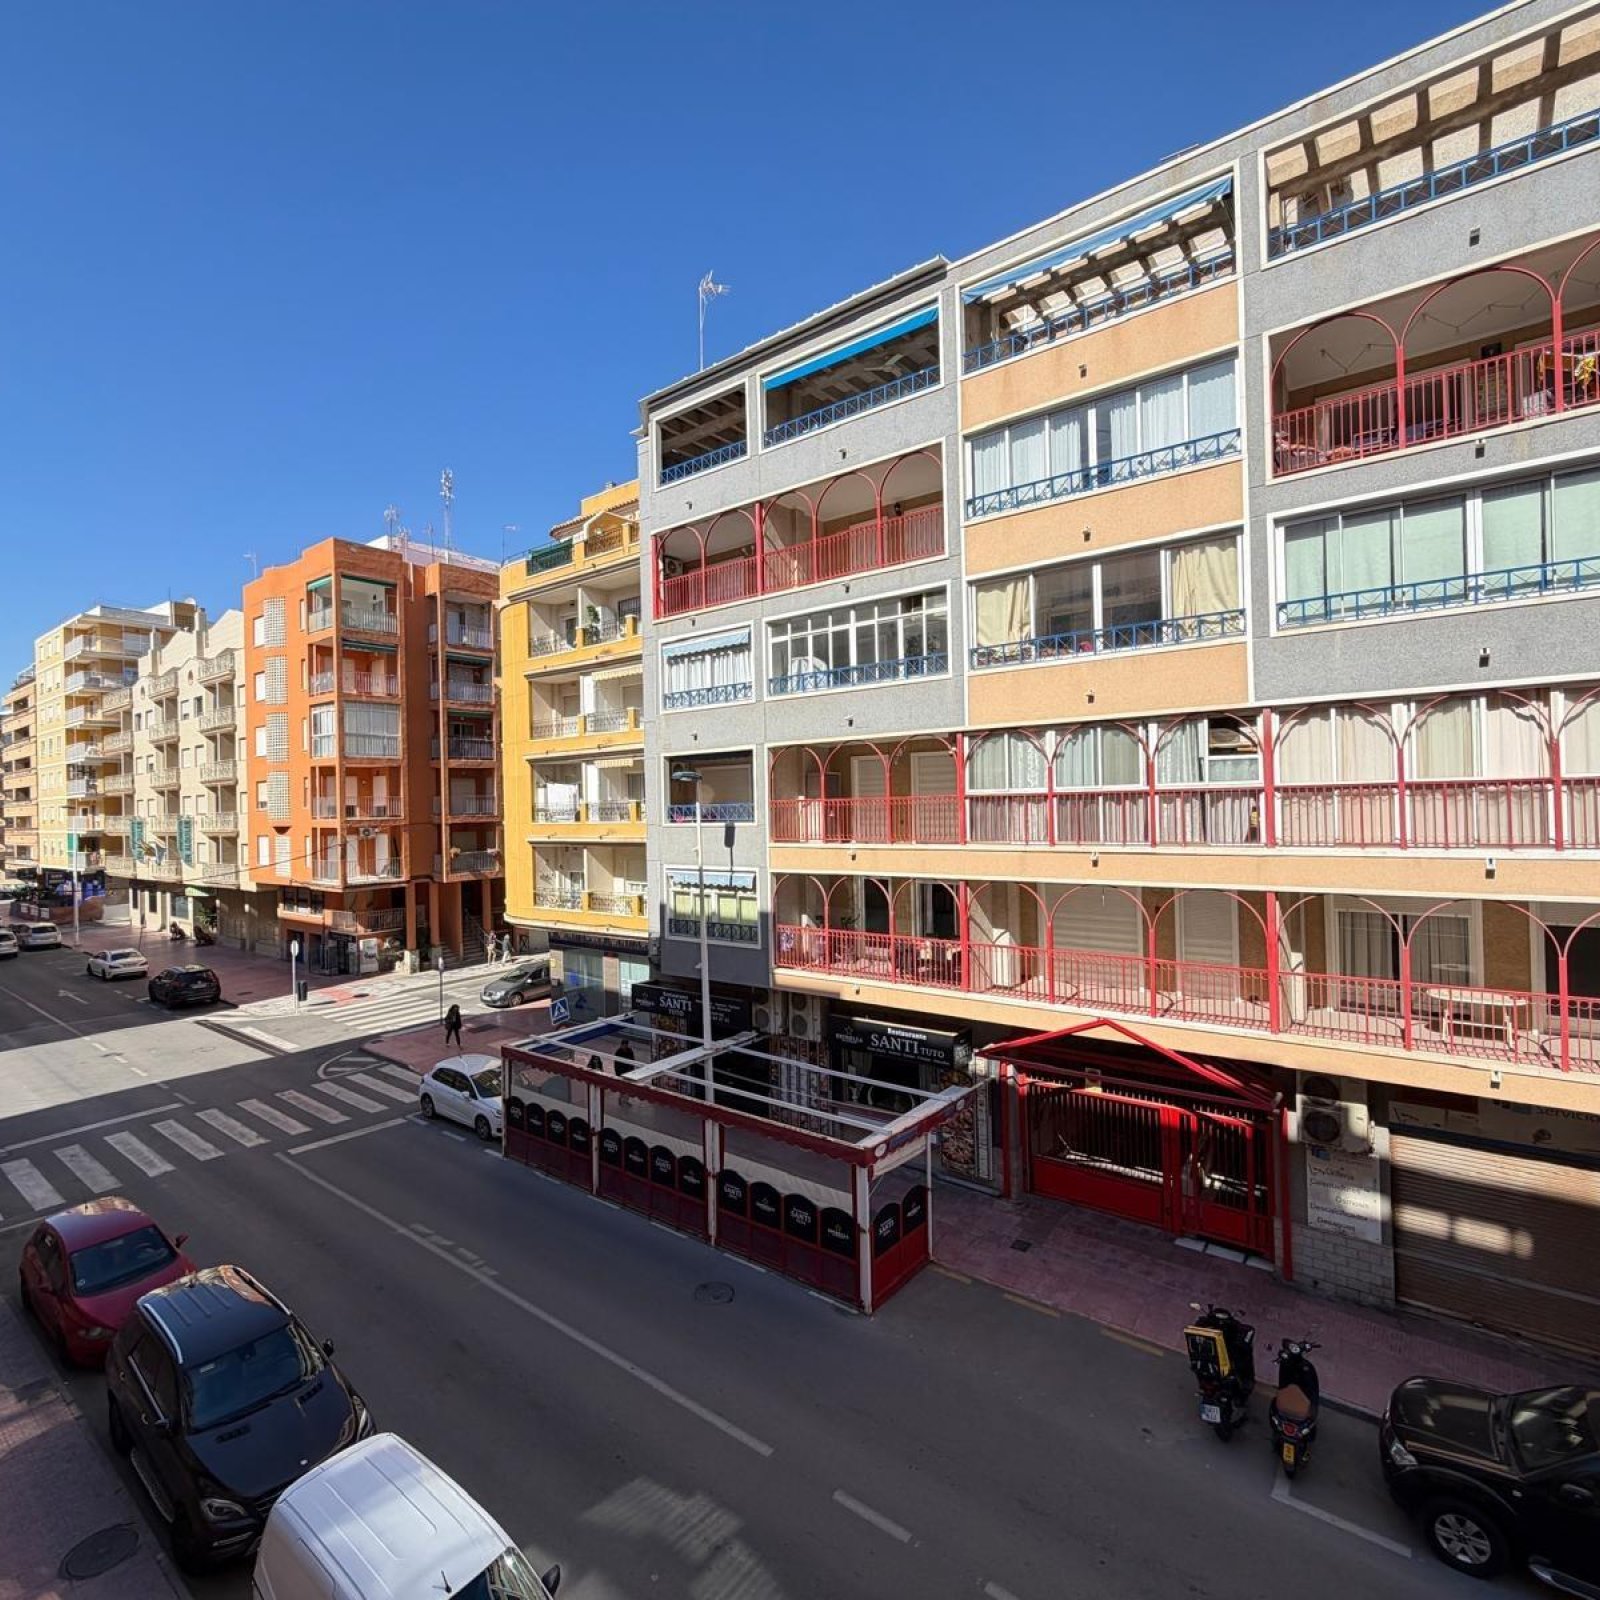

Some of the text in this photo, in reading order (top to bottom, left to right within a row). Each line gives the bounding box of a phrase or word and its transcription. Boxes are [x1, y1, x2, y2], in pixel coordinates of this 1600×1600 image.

[660, 996, 692, 1012] SANTI
[870, 1033, 919, 1054] SANTI
[920, 1047, 945, 1058] TUTO
